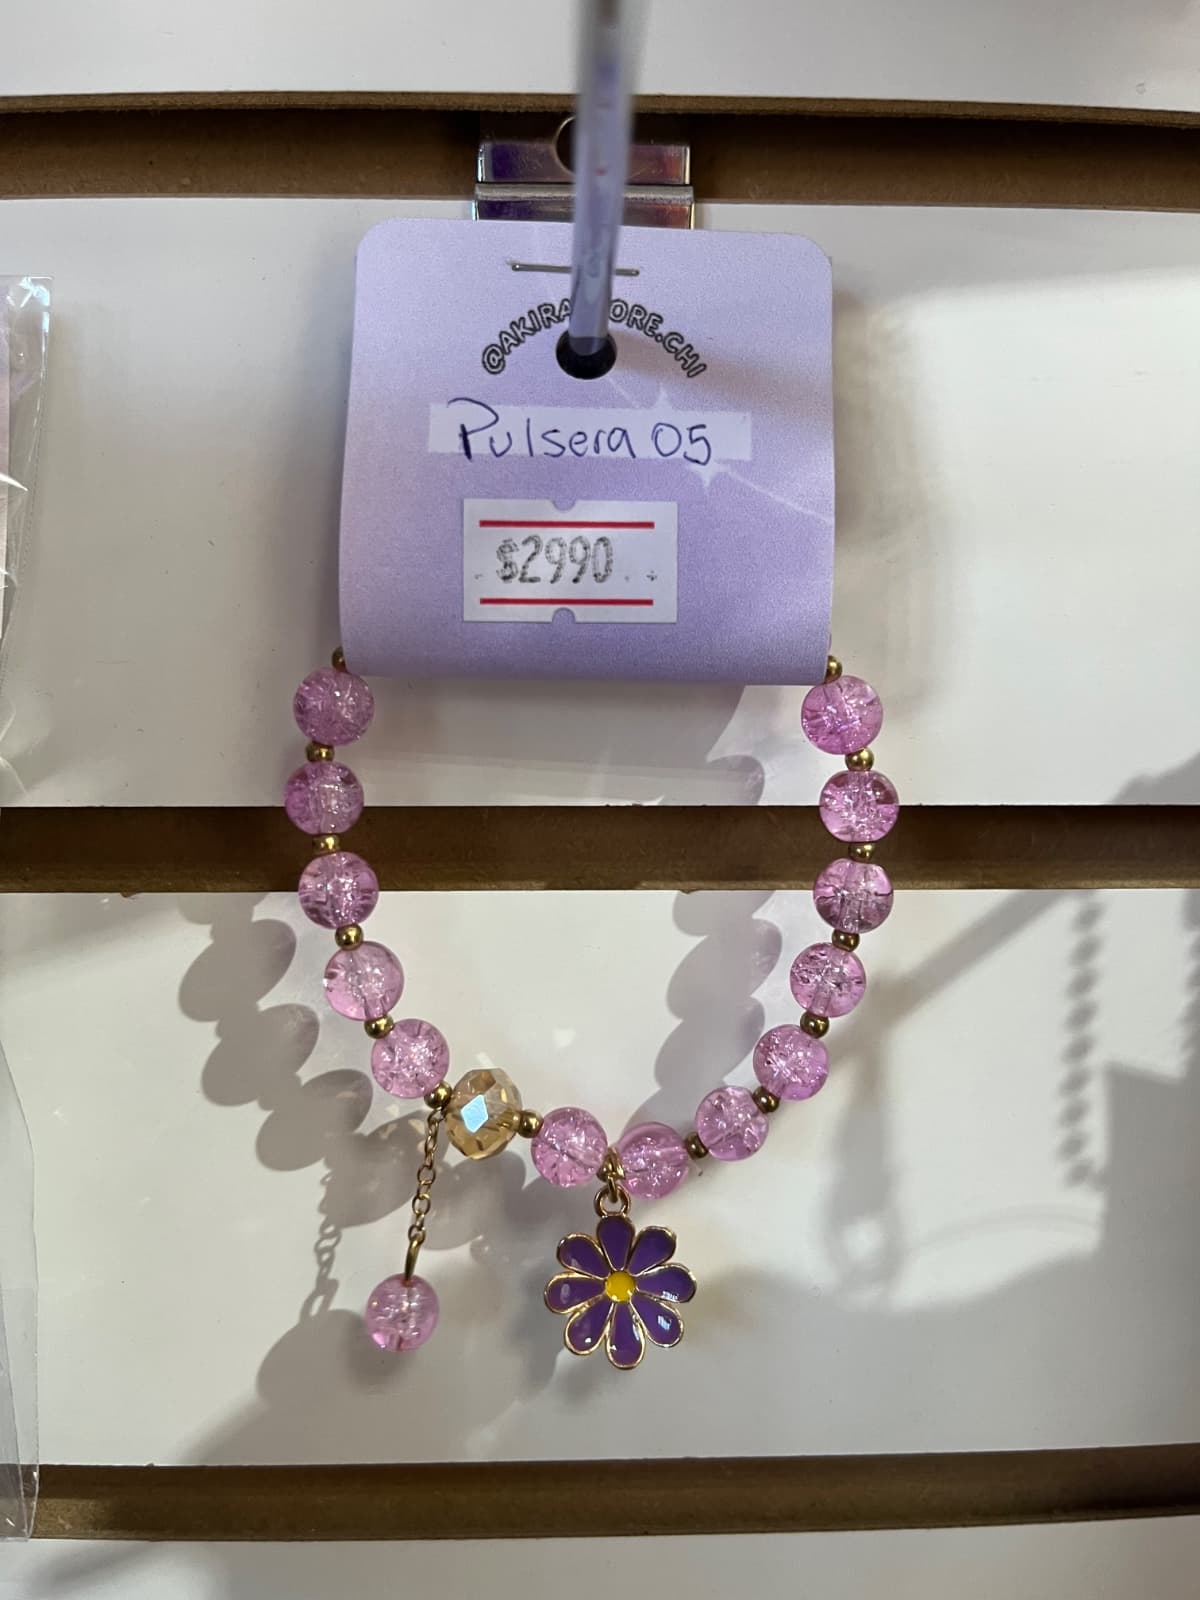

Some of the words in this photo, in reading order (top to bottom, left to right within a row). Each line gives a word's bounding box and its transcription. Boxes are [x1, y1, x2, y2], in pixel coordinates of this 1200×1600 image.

[481, 298, 707, 379] @AKIRAORE.CHI
[447, 397, 636, 461] Pulsera
[651, 421, 712, 466] 05
[495, 534, 614, 584] $2990
